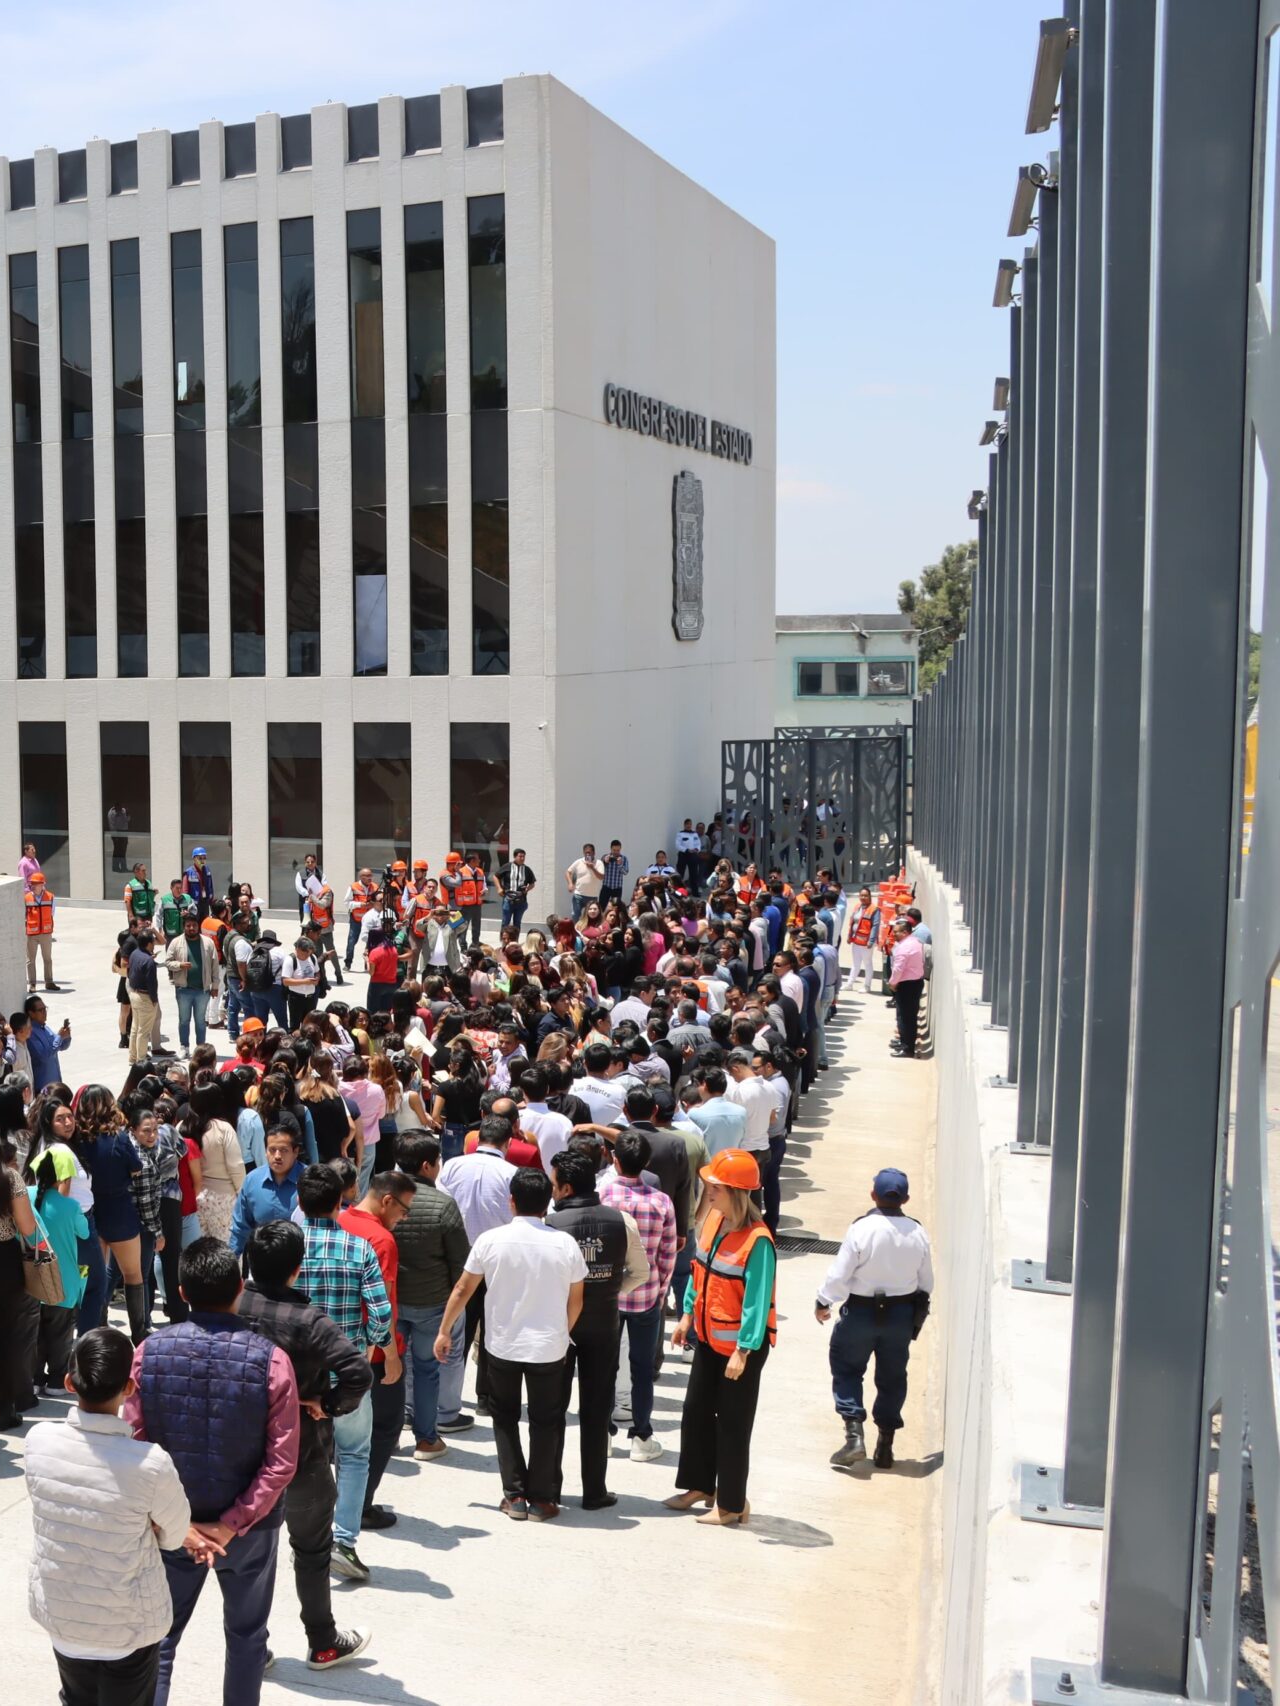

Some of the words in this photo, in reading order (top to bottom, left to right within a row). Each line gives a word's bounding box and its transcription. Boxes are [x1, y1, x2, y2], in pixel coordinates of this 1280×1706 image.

[603, 383, 686, 446] CONGRESO
[686, 411, 711, 453] DEL
[711, 420, 753, 466] ESTADO
